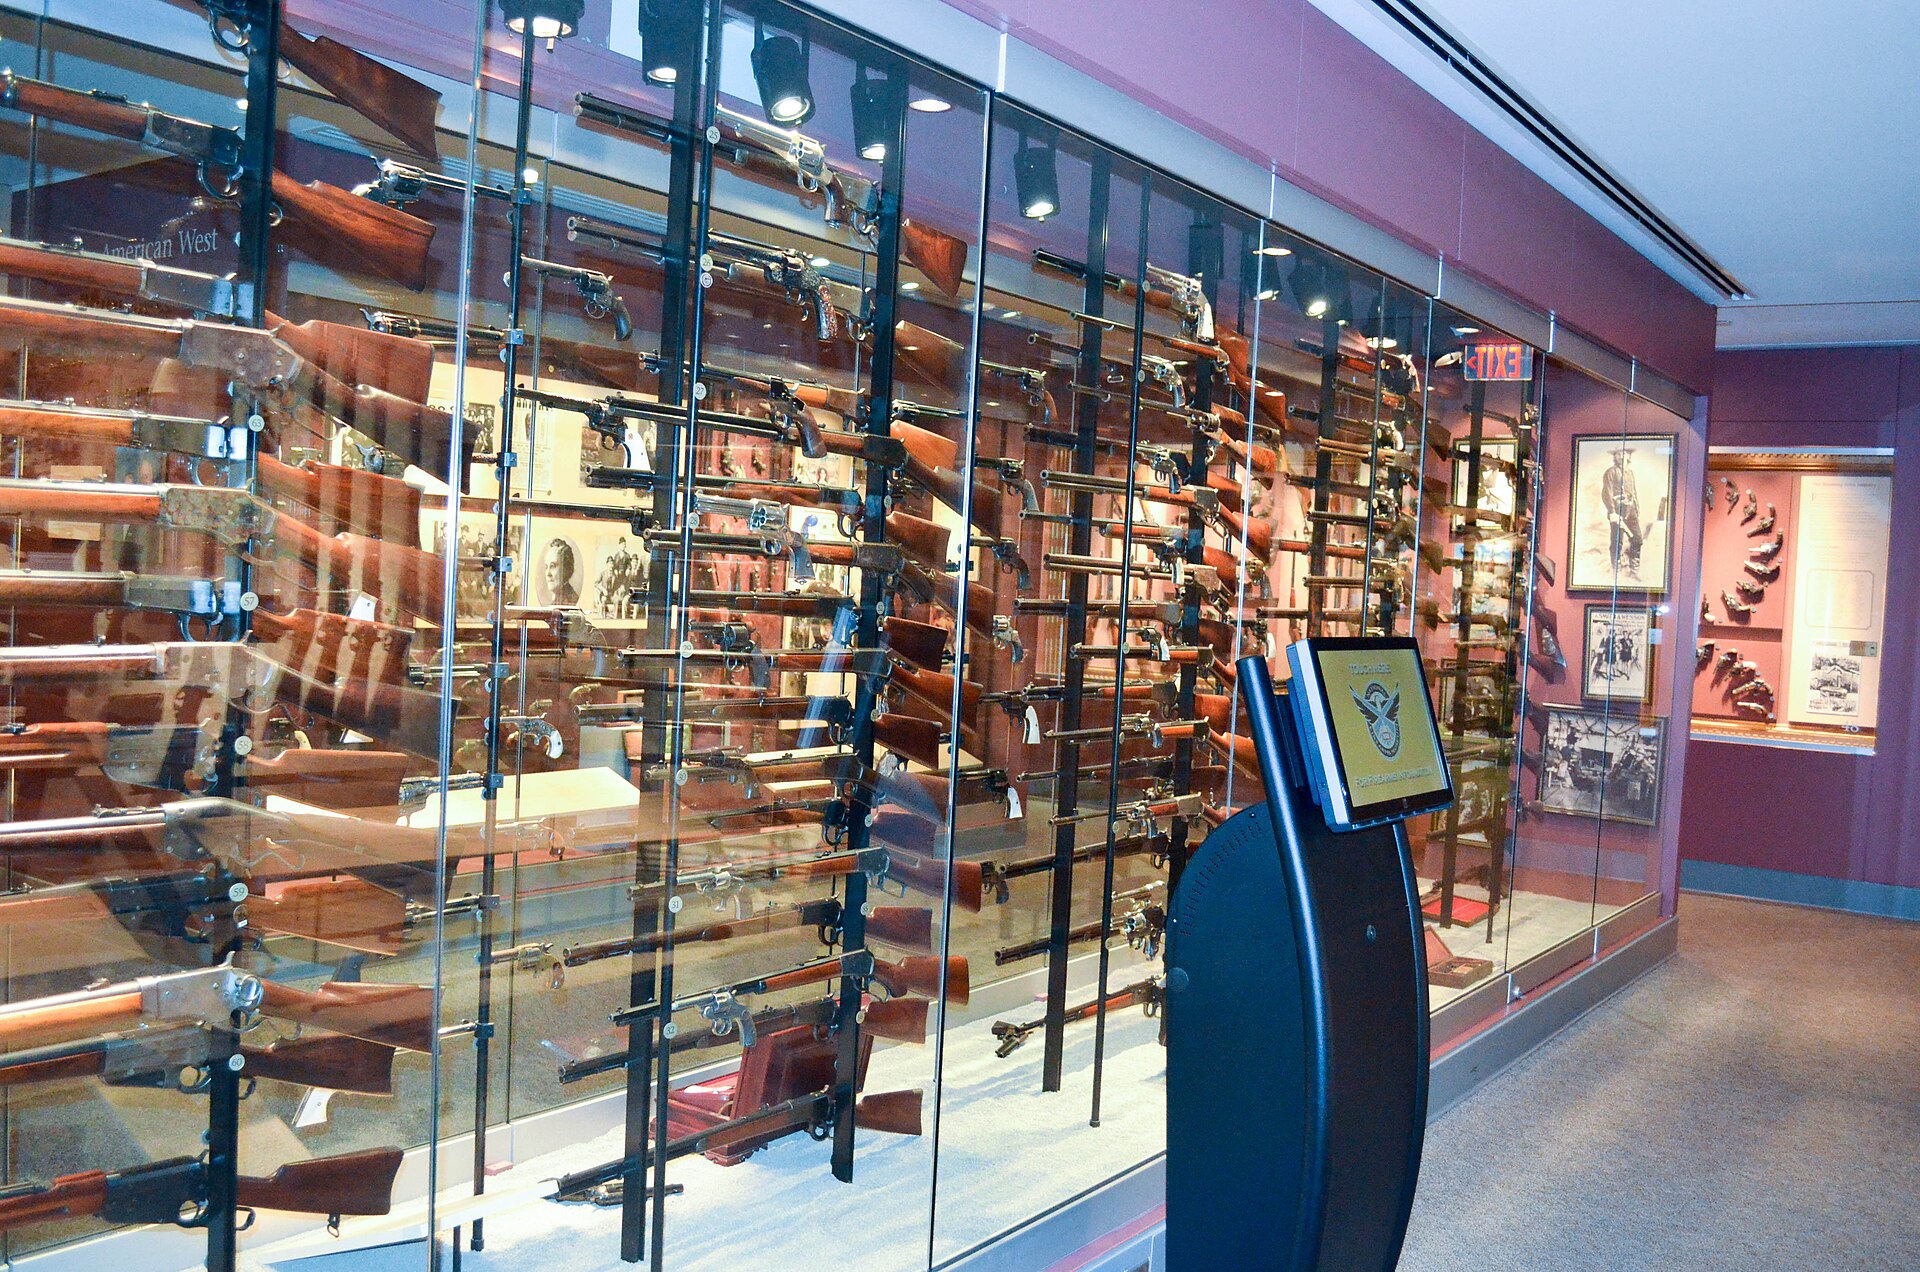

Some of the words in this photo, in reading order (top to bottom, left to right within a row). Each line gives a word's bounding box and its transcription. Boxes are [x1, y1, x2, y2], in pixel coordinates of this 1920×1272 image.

[102, 238, 173, 260] American
[178, 228, 219, 256] West
[243, 596, 256, 606] 57
[232, 887, 245, 898] 59
[231, 1057, 243, 1067] 60
